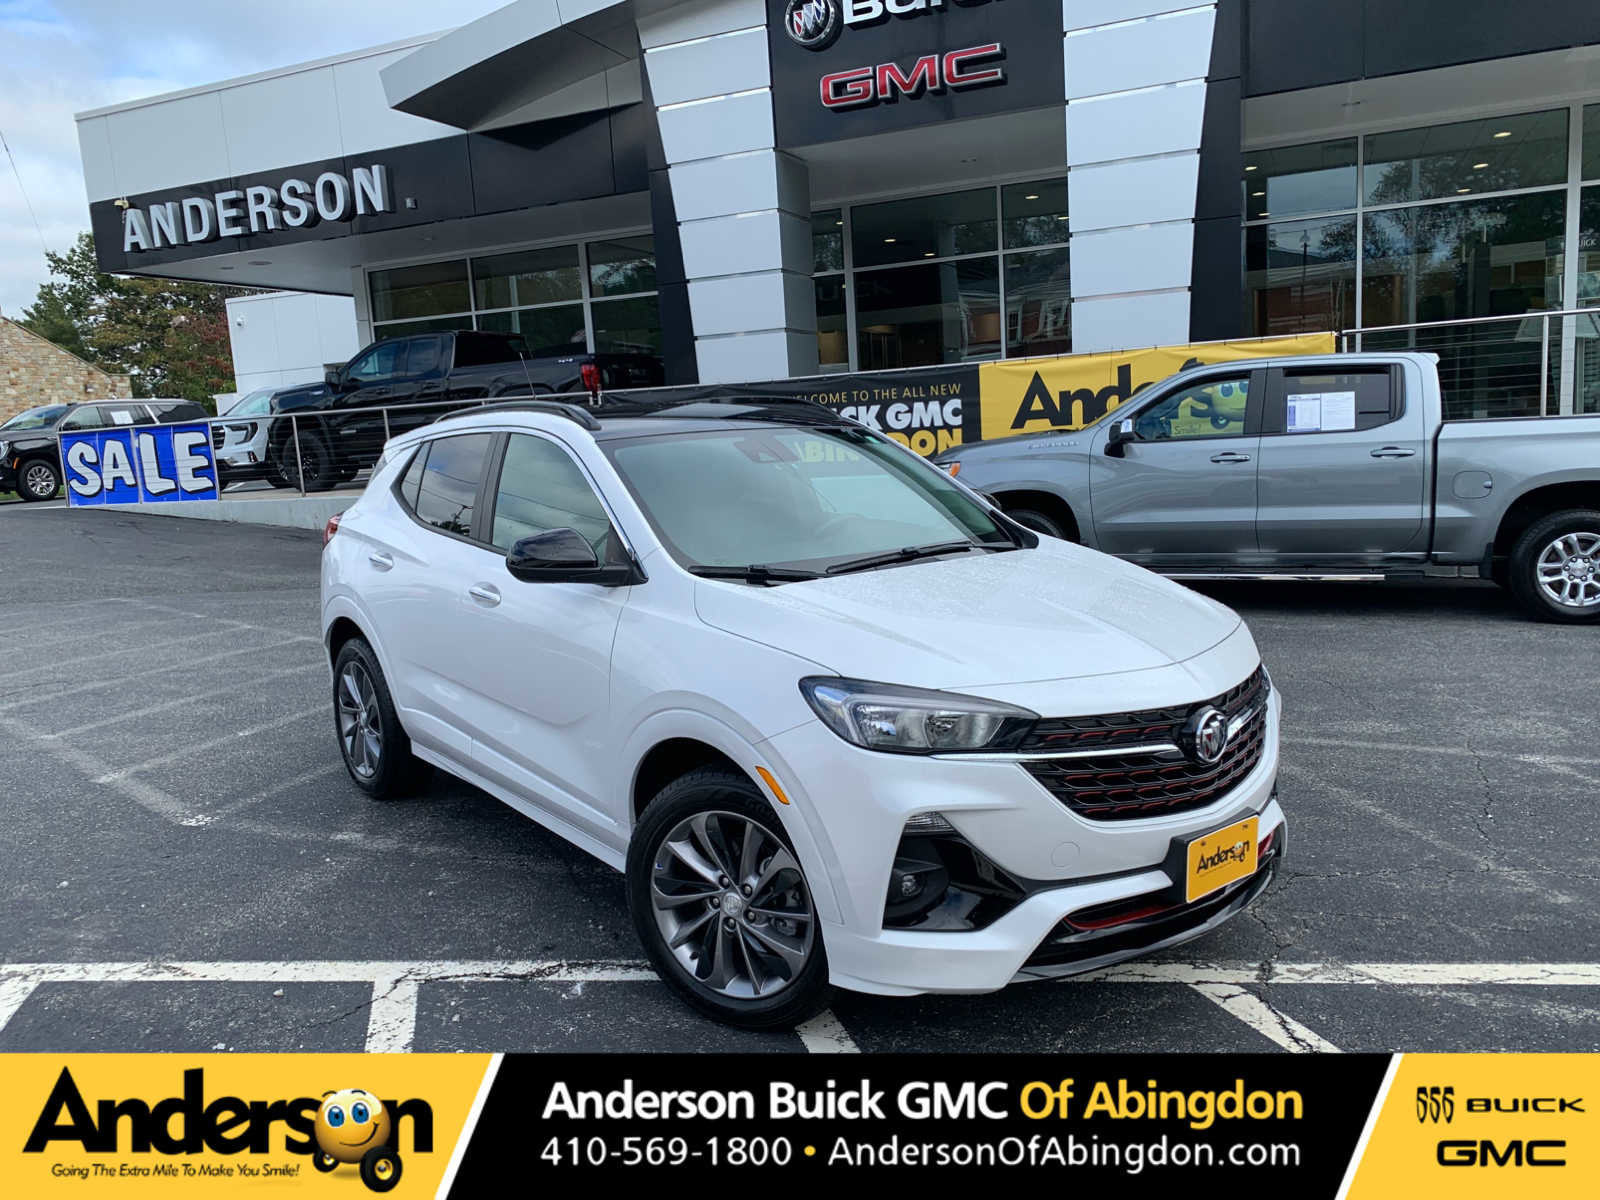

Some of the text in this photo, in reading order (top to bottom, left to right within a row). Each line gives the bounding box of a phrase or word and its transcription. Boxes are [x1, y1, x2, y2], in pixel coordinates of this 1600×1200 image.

[820, 42, 1003, 108] GMC
[123, 164, 389, 252] ANDERSON
[791, 383, 962, 405] LCOME TO THE ALL NEW
[885, 398, 963, 430] GMC
[67, 431, 215, 498] SALE
